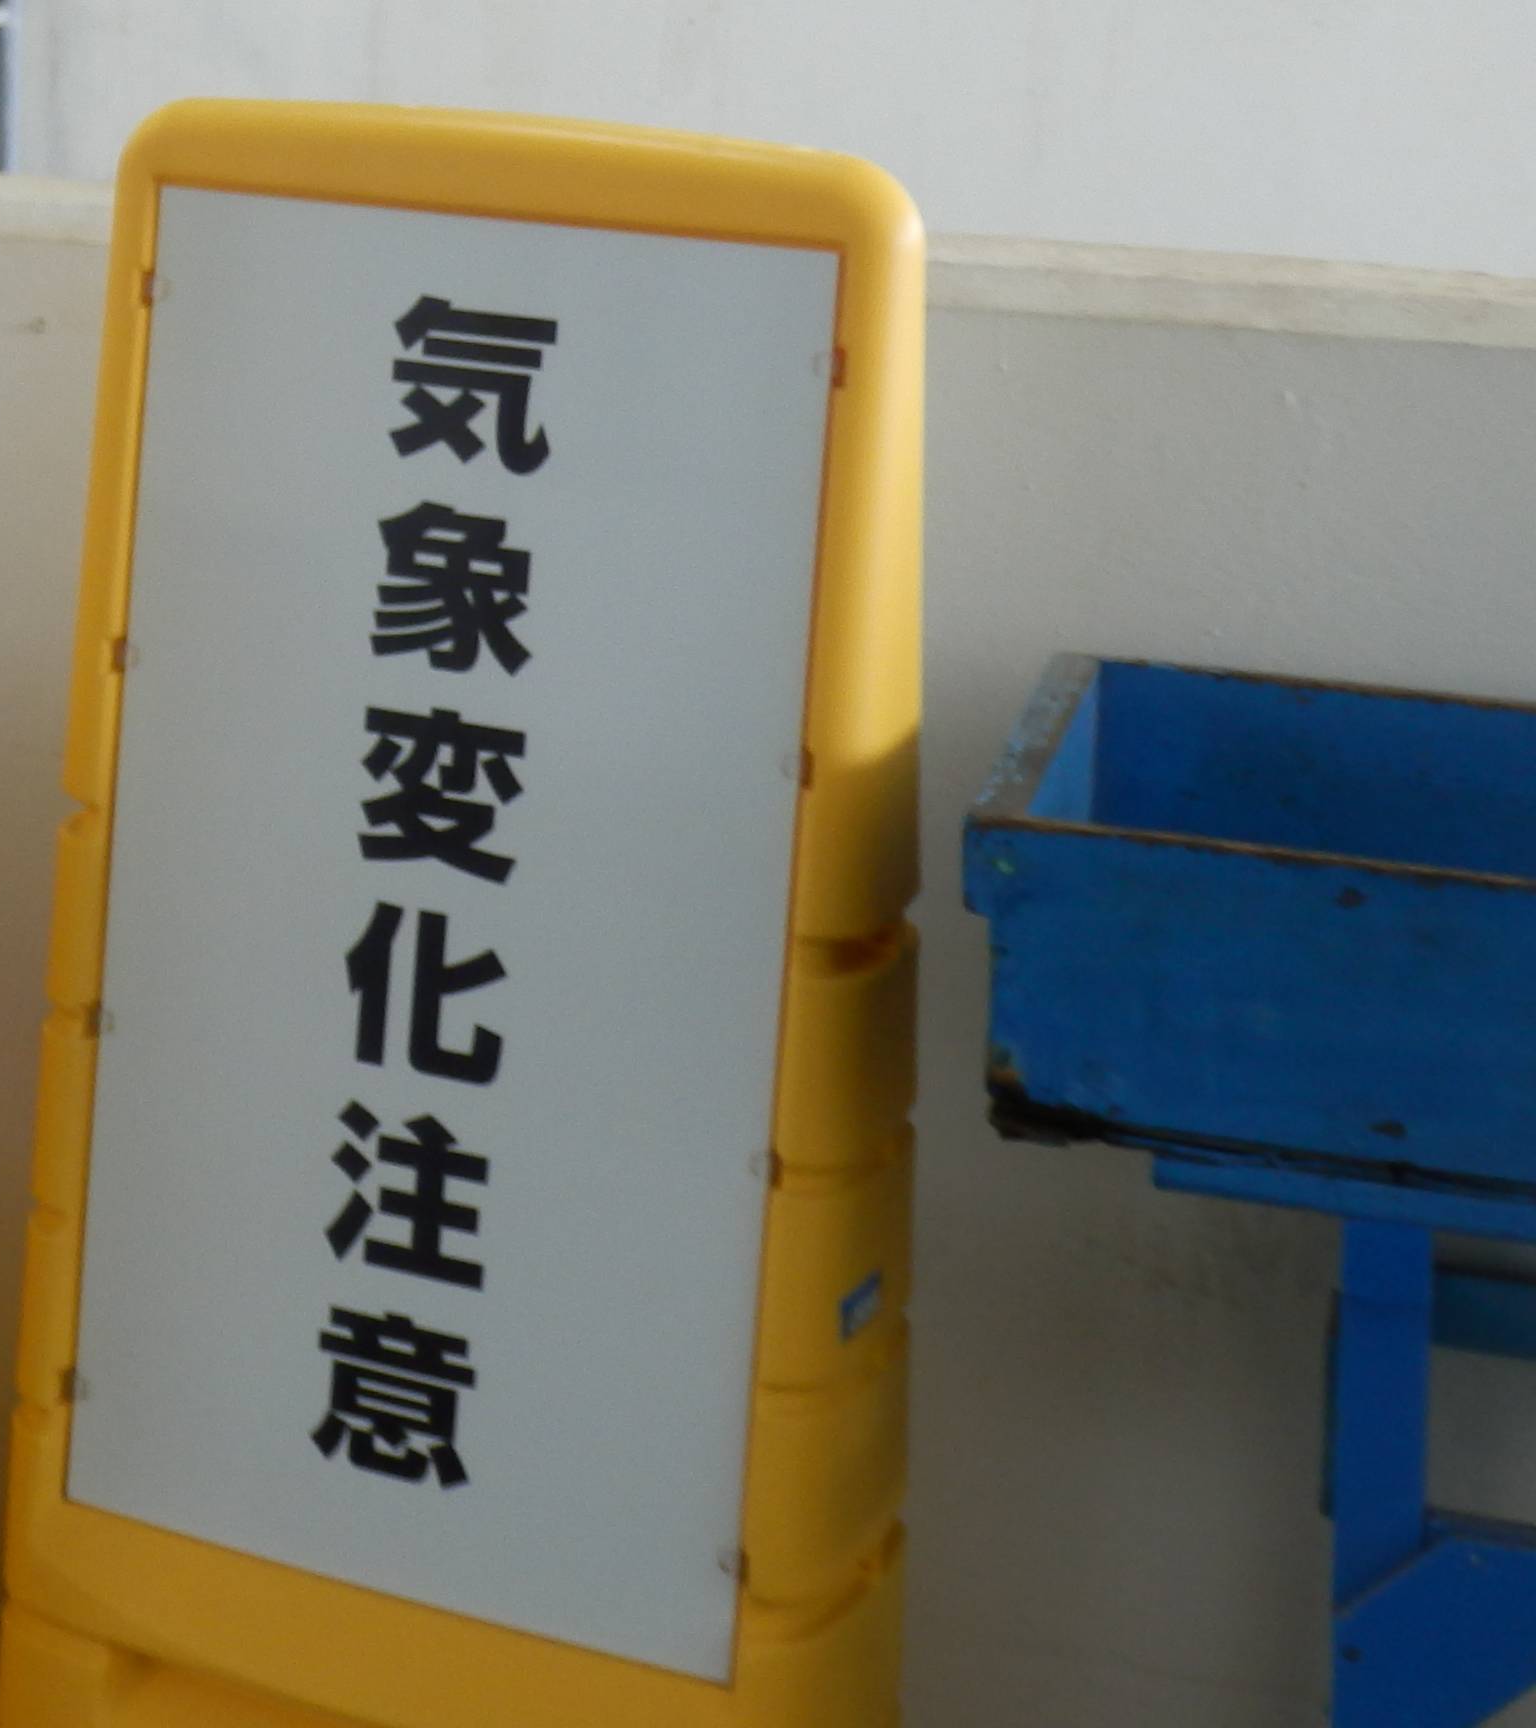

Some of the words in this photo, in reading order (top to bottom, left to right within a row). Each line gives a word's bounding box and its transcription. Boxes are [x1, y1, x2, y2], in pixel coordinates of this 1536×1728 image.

[309, 295, 559, 1490] 気象変化注意
